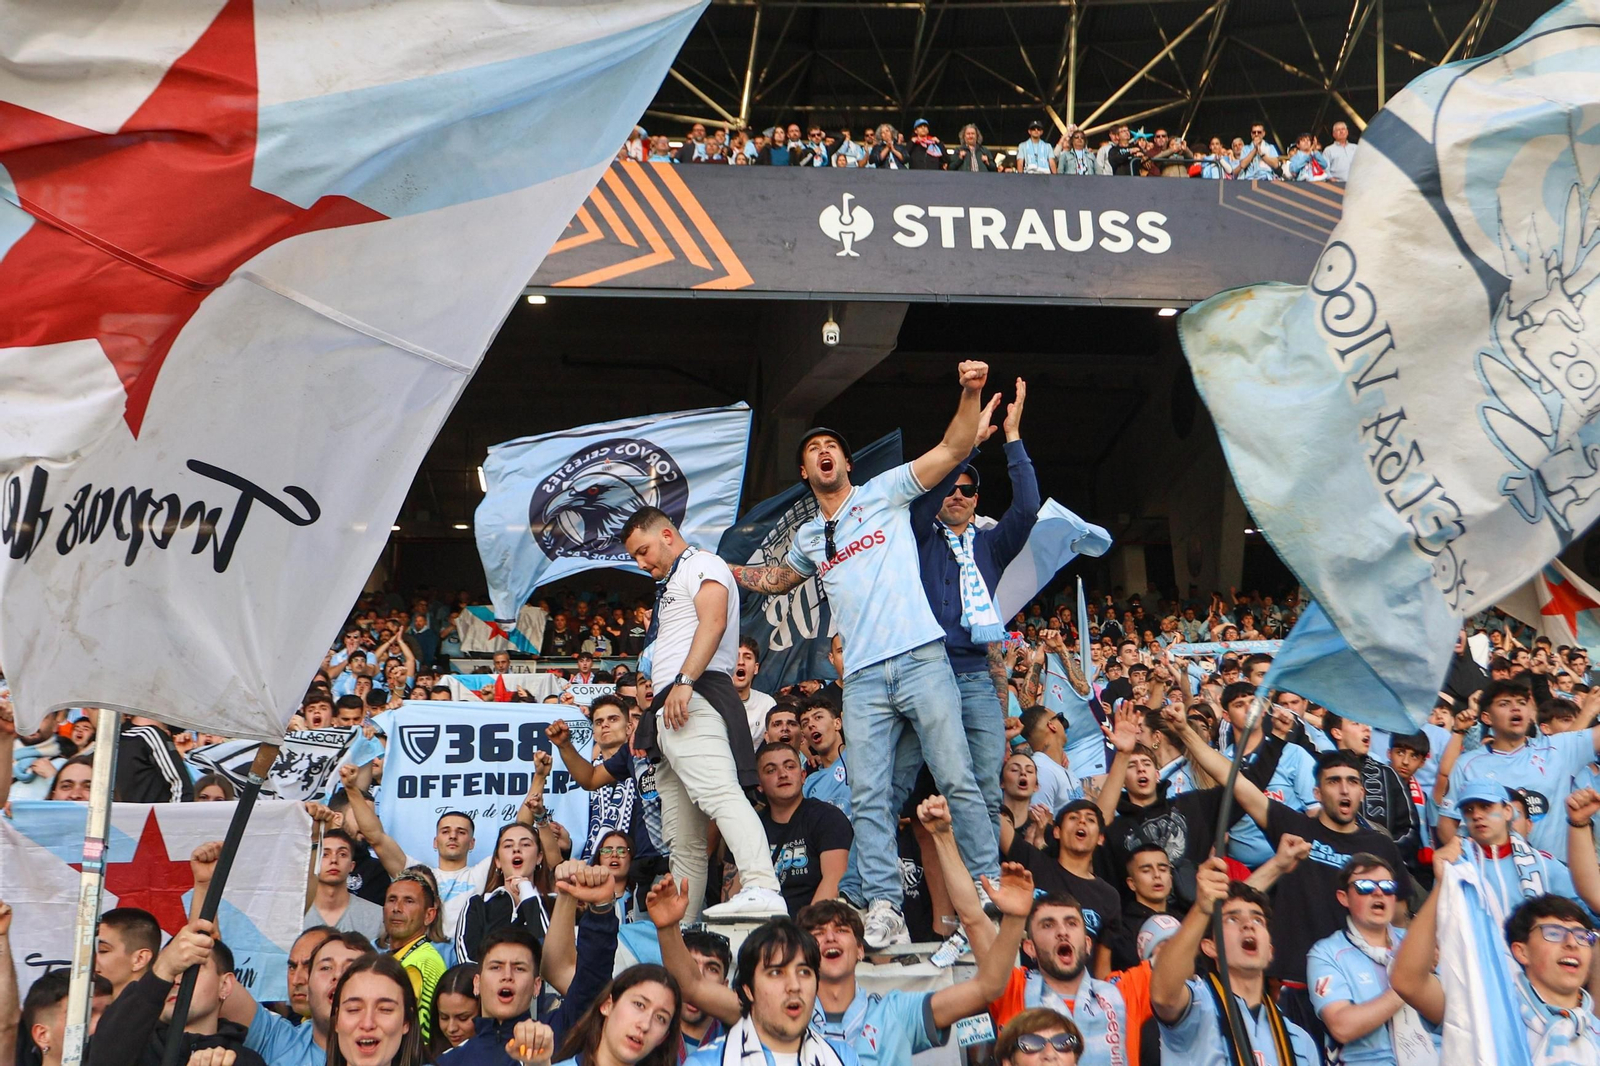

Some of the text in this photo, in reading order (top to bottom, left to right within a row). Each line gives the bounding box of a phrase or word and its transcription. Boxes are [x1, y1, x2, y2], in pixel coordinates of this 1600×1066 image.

[893, 203, 1172, 255] STRAUSS
[284, 730, 346, 745] ALLAECIA
[444, 722, 552, 764] 368
[482, 803, 497, 818] de
